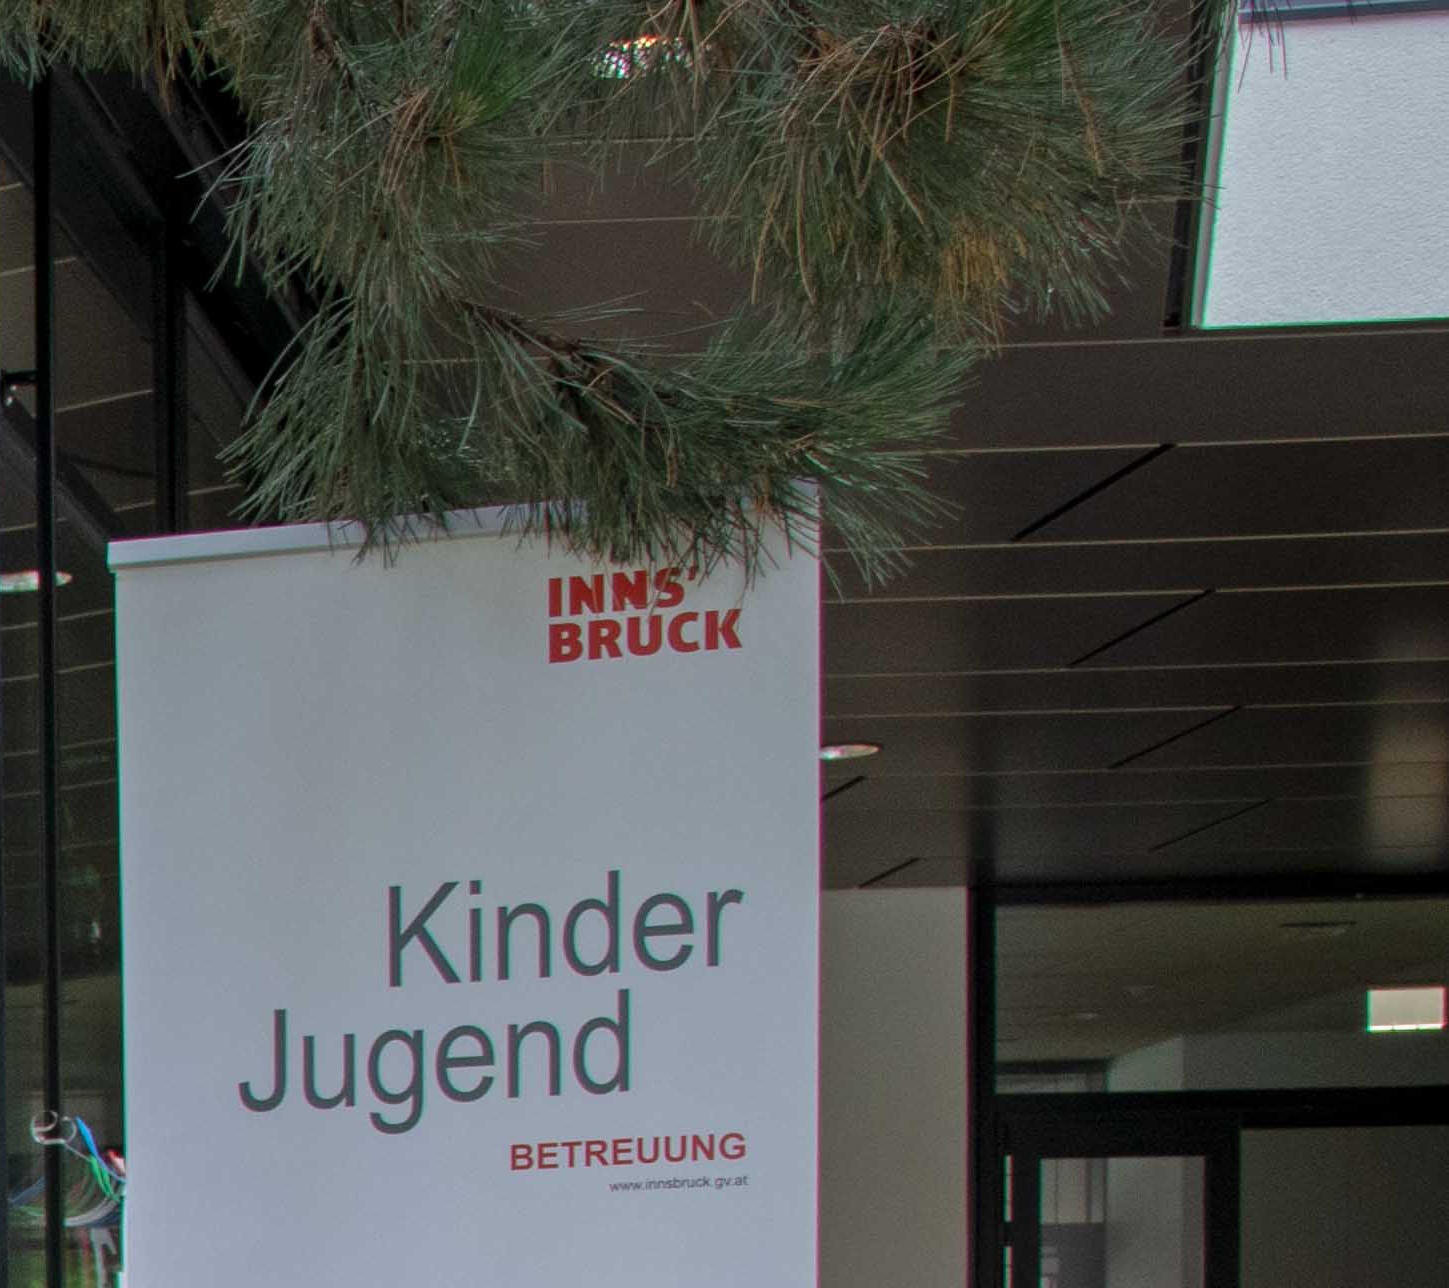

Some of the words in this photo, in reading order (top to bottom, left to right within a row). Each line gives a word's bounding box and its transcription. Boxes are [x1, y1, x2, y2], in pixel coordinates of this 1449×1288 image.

[548, 609, 743, 664] BRUCK
[388, 869, 744, 988] Kinder
[238, 988, 632, 1135] Jugend
[510, 1132, 747, 1171] BETREUUNG
[609, 1174, 749, 1193] www.innsbruck.gv.at
